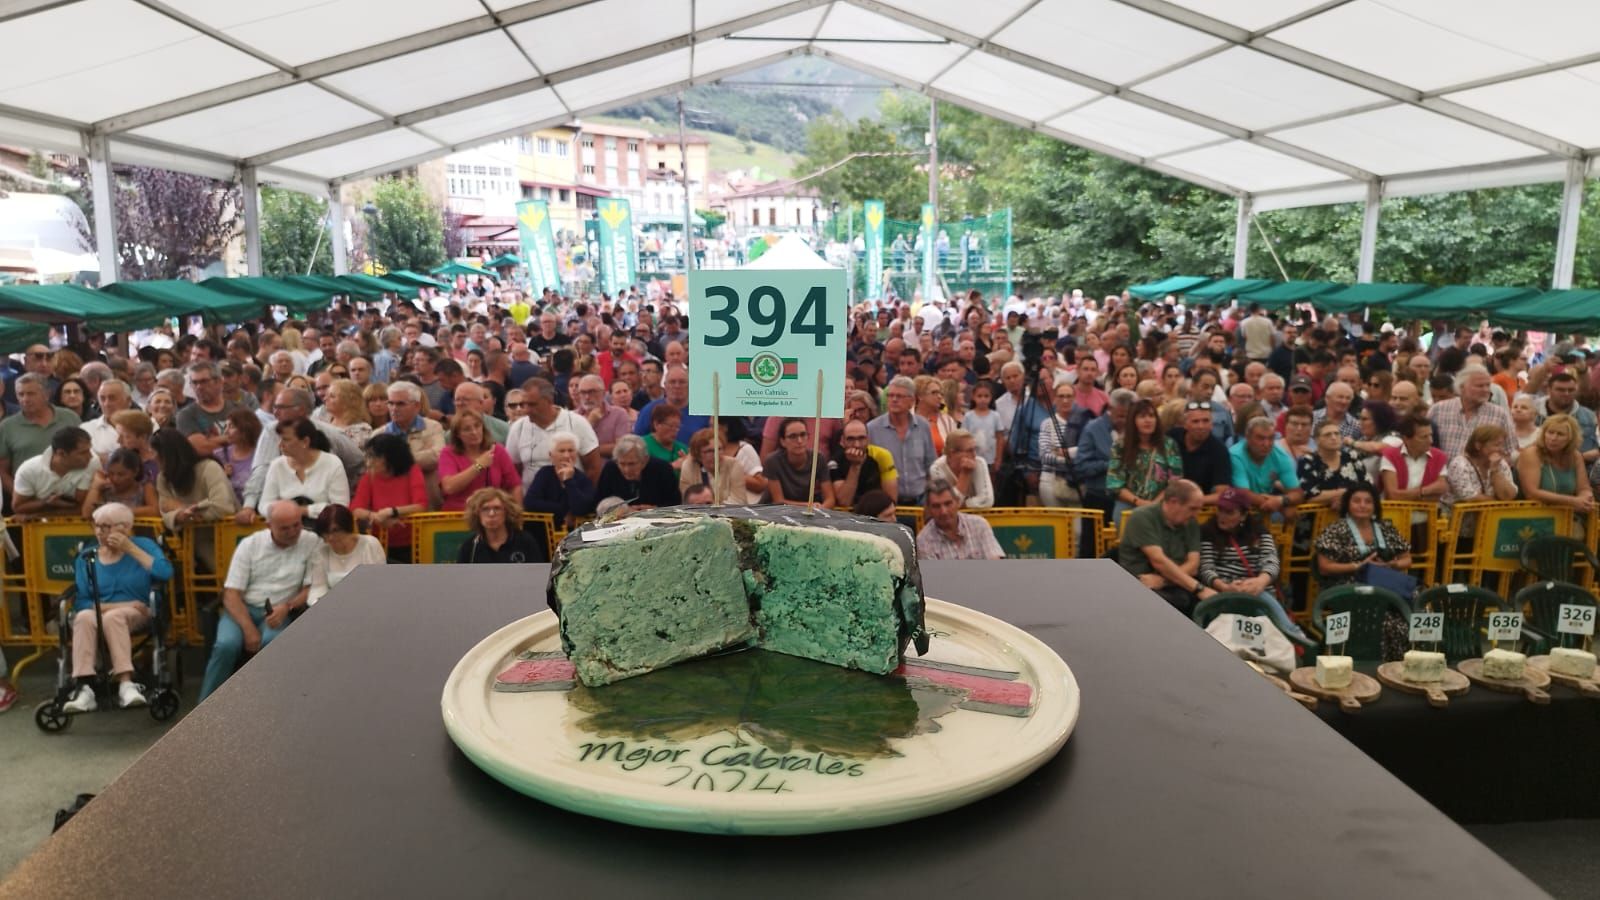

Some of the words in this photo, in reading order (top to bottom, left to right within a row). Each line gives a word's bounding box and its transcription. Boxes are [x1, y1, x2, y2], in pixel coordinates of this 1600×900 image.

[704, 285, 834, 347] 394
[745, 388, 763, 396] Queso
[765, 388, 789, 396] Cabrales
[1492, 615, 1519, 628] 636
[1562, 608, 1592, 621] 326
[1235, 619, 1263, 636] 189
[1329, 615, 1349, 631] 282
[1413, 616, 1441, 629] 248
[579, 741, 690, 771] Mejor
[701, 744, 865, 777] Cabrales
